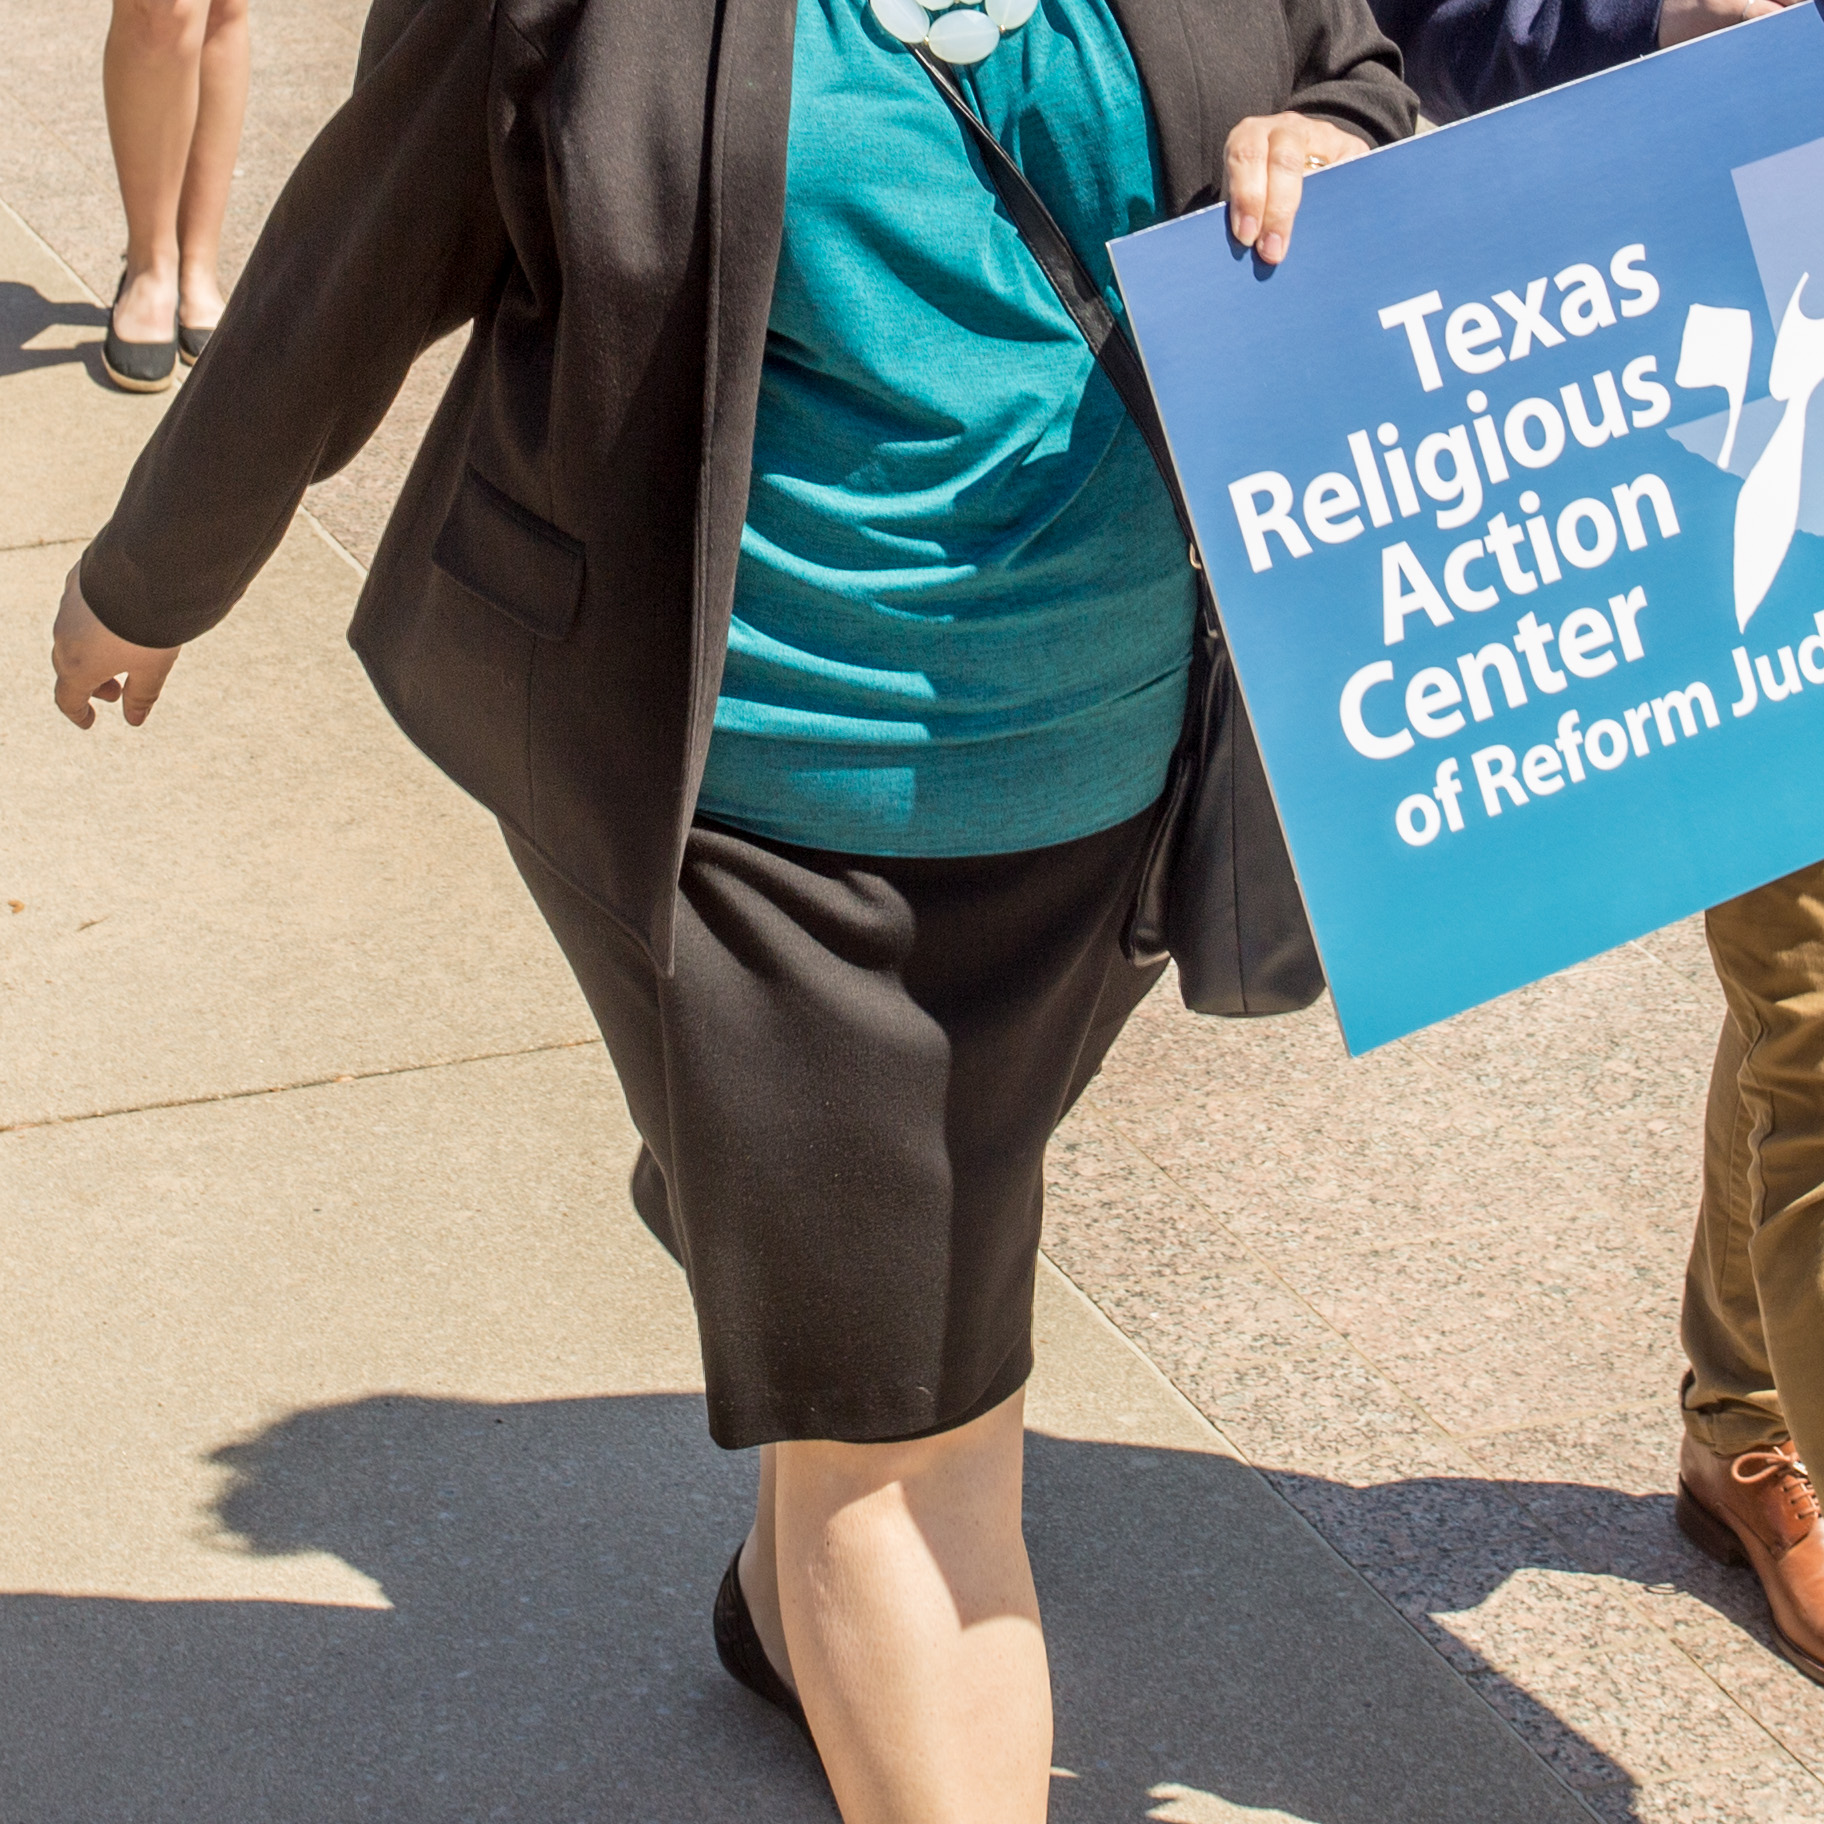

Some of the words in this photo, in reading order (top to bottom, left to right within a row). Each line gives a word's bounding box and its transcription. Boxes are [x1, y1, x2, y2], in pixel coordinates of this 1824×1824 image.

[1379, 243, 1661, 392] Texas
[1228, 356, 1672, 574] Religious
[1382, 473, 1680, 646] Action
[1339, 585, 1648, 759] Center
[1395, 758, 1464, 846] of
[1471, 681, 1720, 817] Reform
